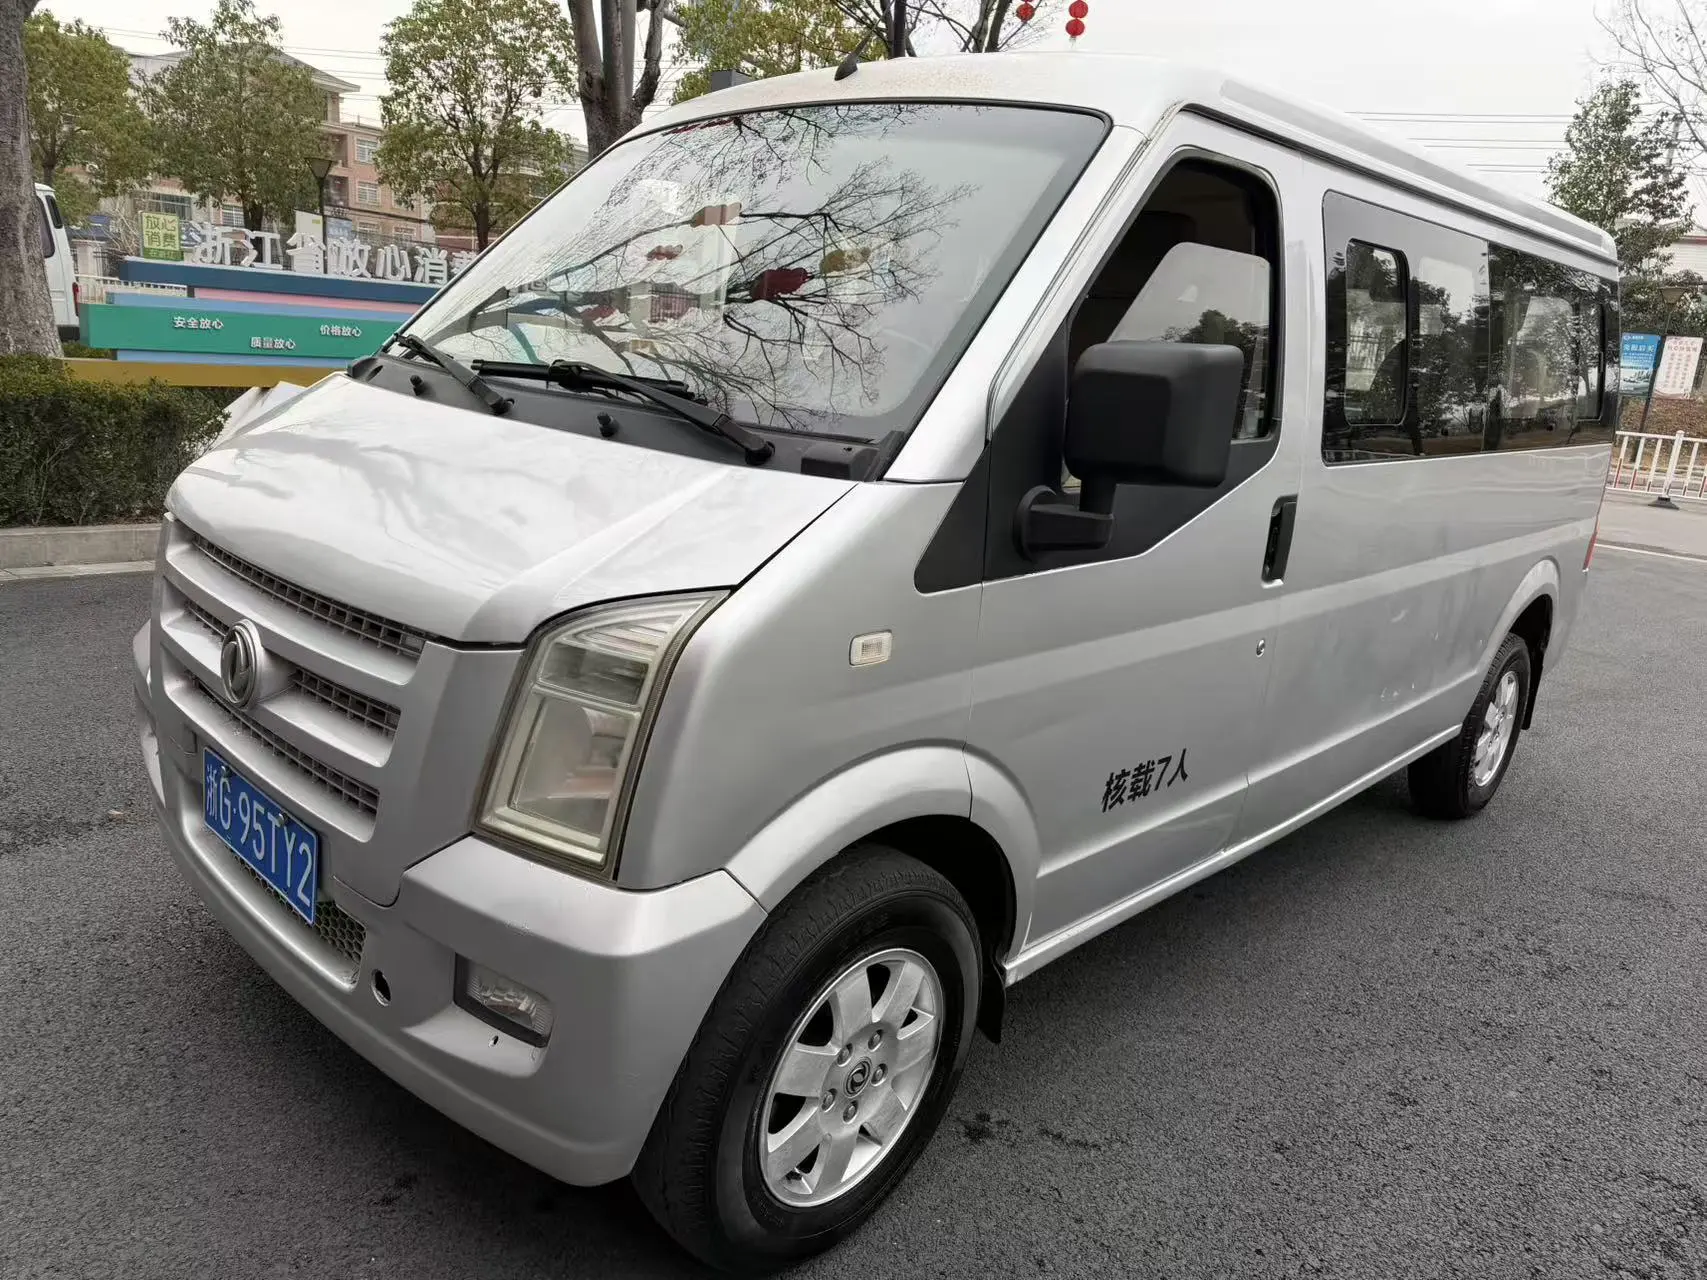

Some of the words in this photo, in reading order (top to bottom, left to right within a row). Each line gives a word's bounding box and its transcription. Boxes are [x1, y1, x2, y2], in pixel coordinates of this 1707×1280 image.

[145, 215, 177, 231] 放心
[145, 231, 177, 249] 消费
[173, 316, 224, 330] 安全放心
[320, 324, 362, 338] 价格放心
[250, 336, 297, 350] 质量放心
[1101, 748, 1188, 813] 核载7人
